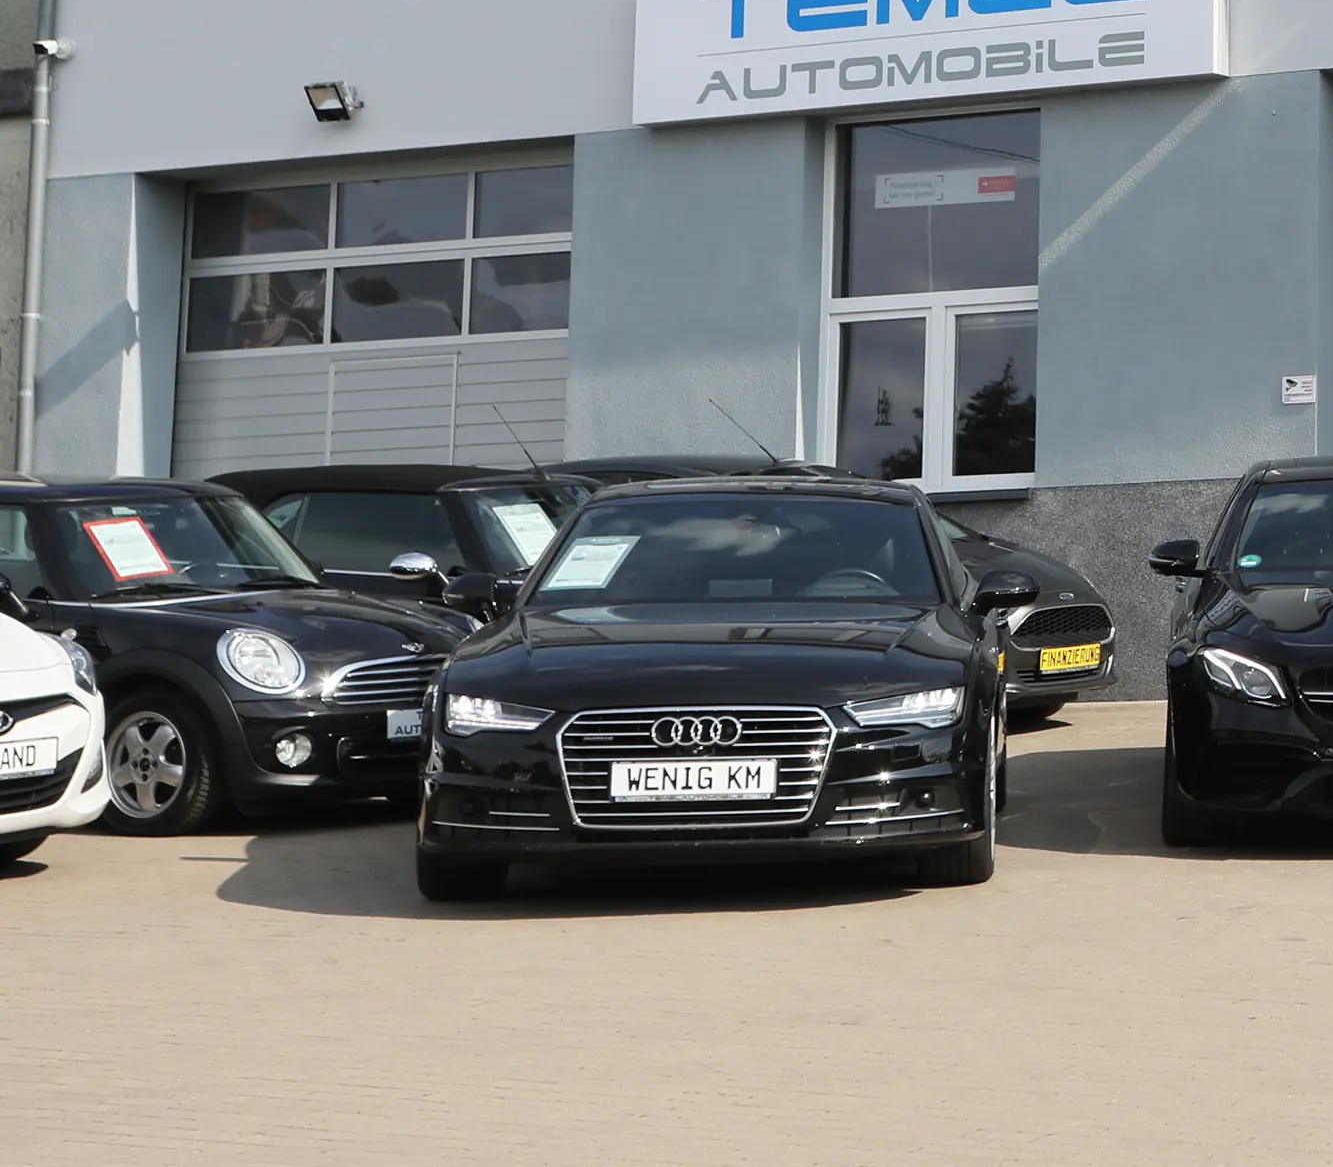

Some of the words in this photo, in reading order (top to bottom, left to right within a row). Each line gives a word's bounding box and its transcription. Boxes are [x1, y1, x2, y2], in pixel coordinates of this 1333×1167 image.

[1042, 646, 1100, 668] FINANZIERUNG
[627, 767, 712, 791] WENIG
[728, 765, 761, 790] KM
